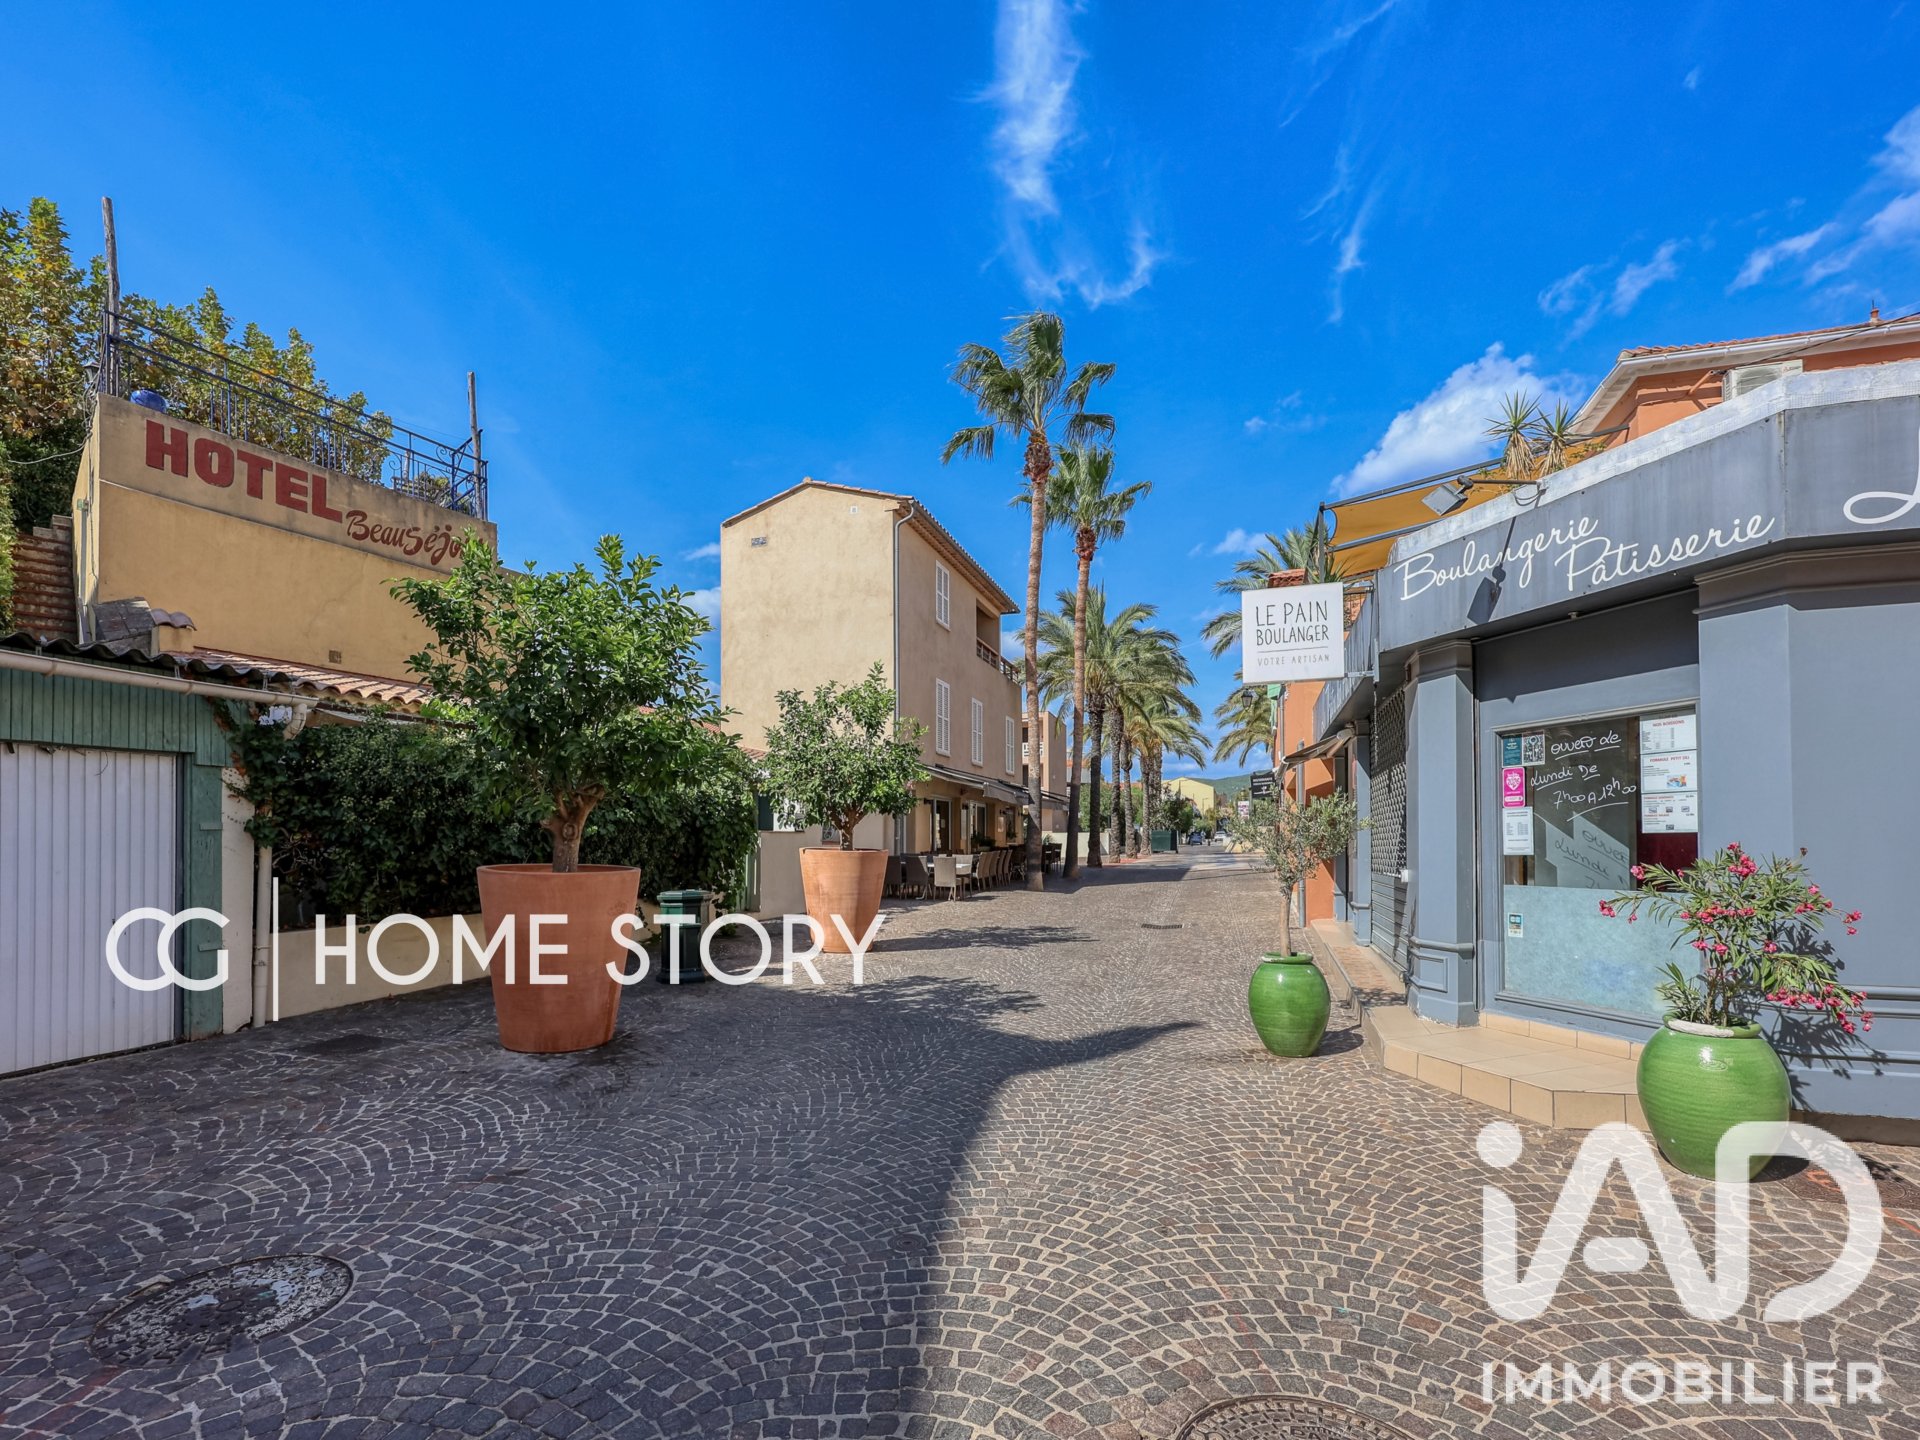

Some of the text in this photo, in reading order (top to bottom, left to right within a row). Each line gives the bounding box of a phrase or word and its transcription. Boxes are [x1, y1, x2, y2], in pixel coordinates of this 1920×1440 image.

[145, 419, 343, 523] HOTEL
[1393, 516, 1599, 600] Boulangerie
[1554, 514, 1776, 592] Pâtisserie
[1255, 600, 1328, 626] LE PAIN
[1256, 624, 1330, 646] BOULANGER
[1257, 654, 1330, 667] VOTRE ARTISAN
